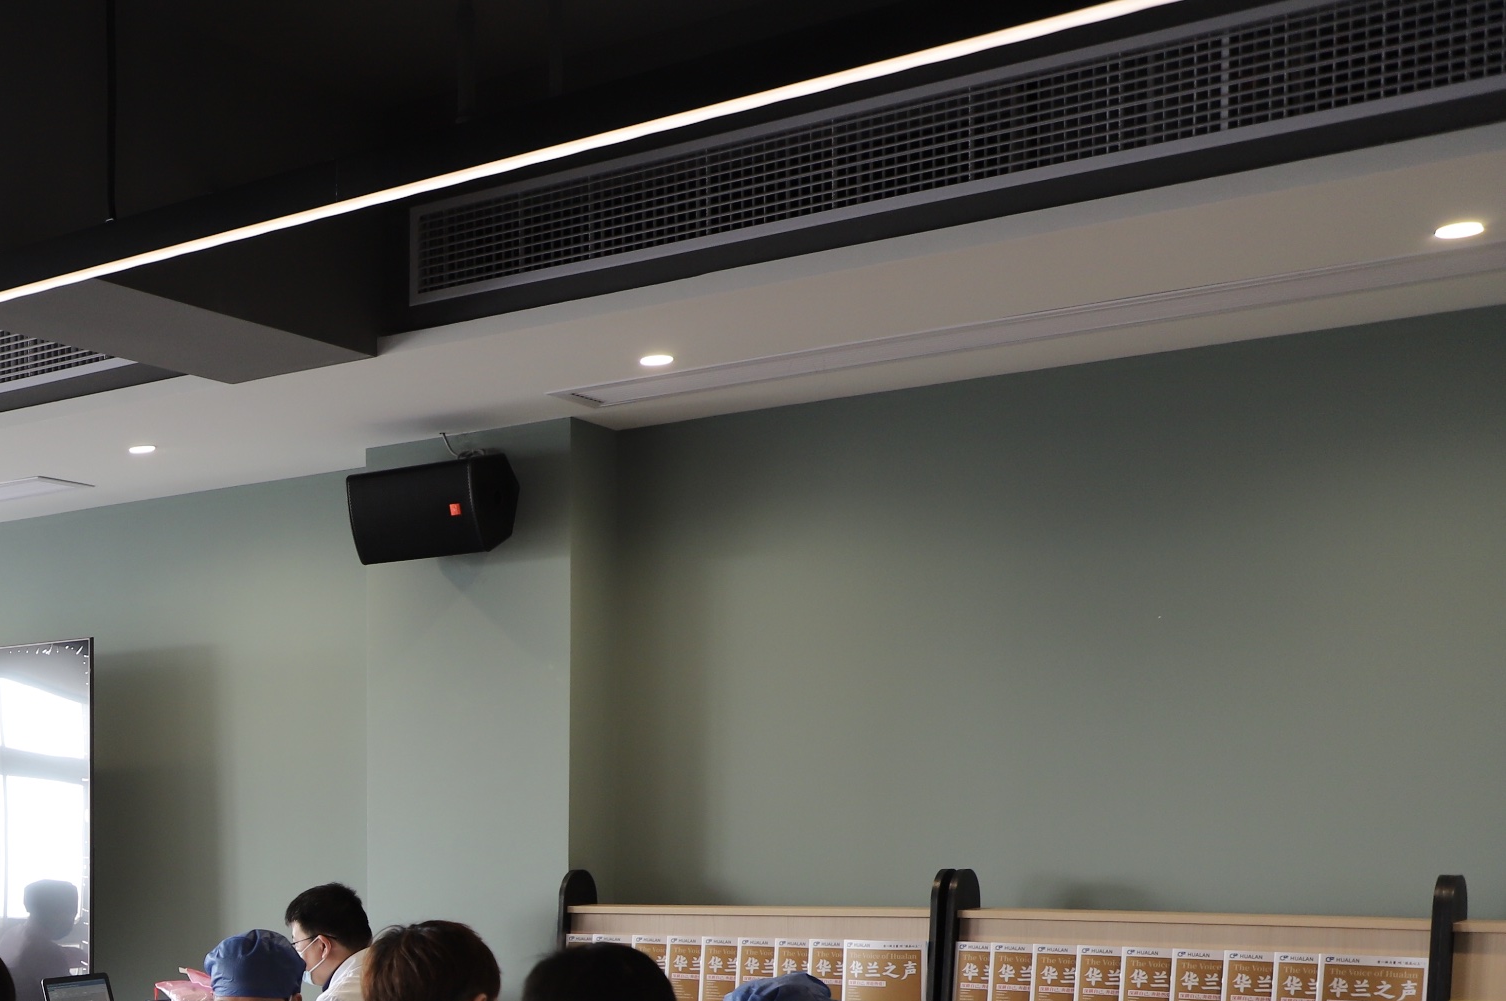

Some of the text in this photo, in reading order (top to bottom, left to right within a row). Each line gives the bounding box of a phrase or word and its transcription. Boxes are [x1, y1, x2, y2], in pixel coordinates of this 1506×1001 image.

[849, 960, 917, 981] 华兰之声
[1128, 968, 1169, 989] 华兰
[1180, 971, 1221, 990] 华兰
[1232, 973, 1272, 993] 华兰
[1328, 977, 1418, 1001] 华兰之声
